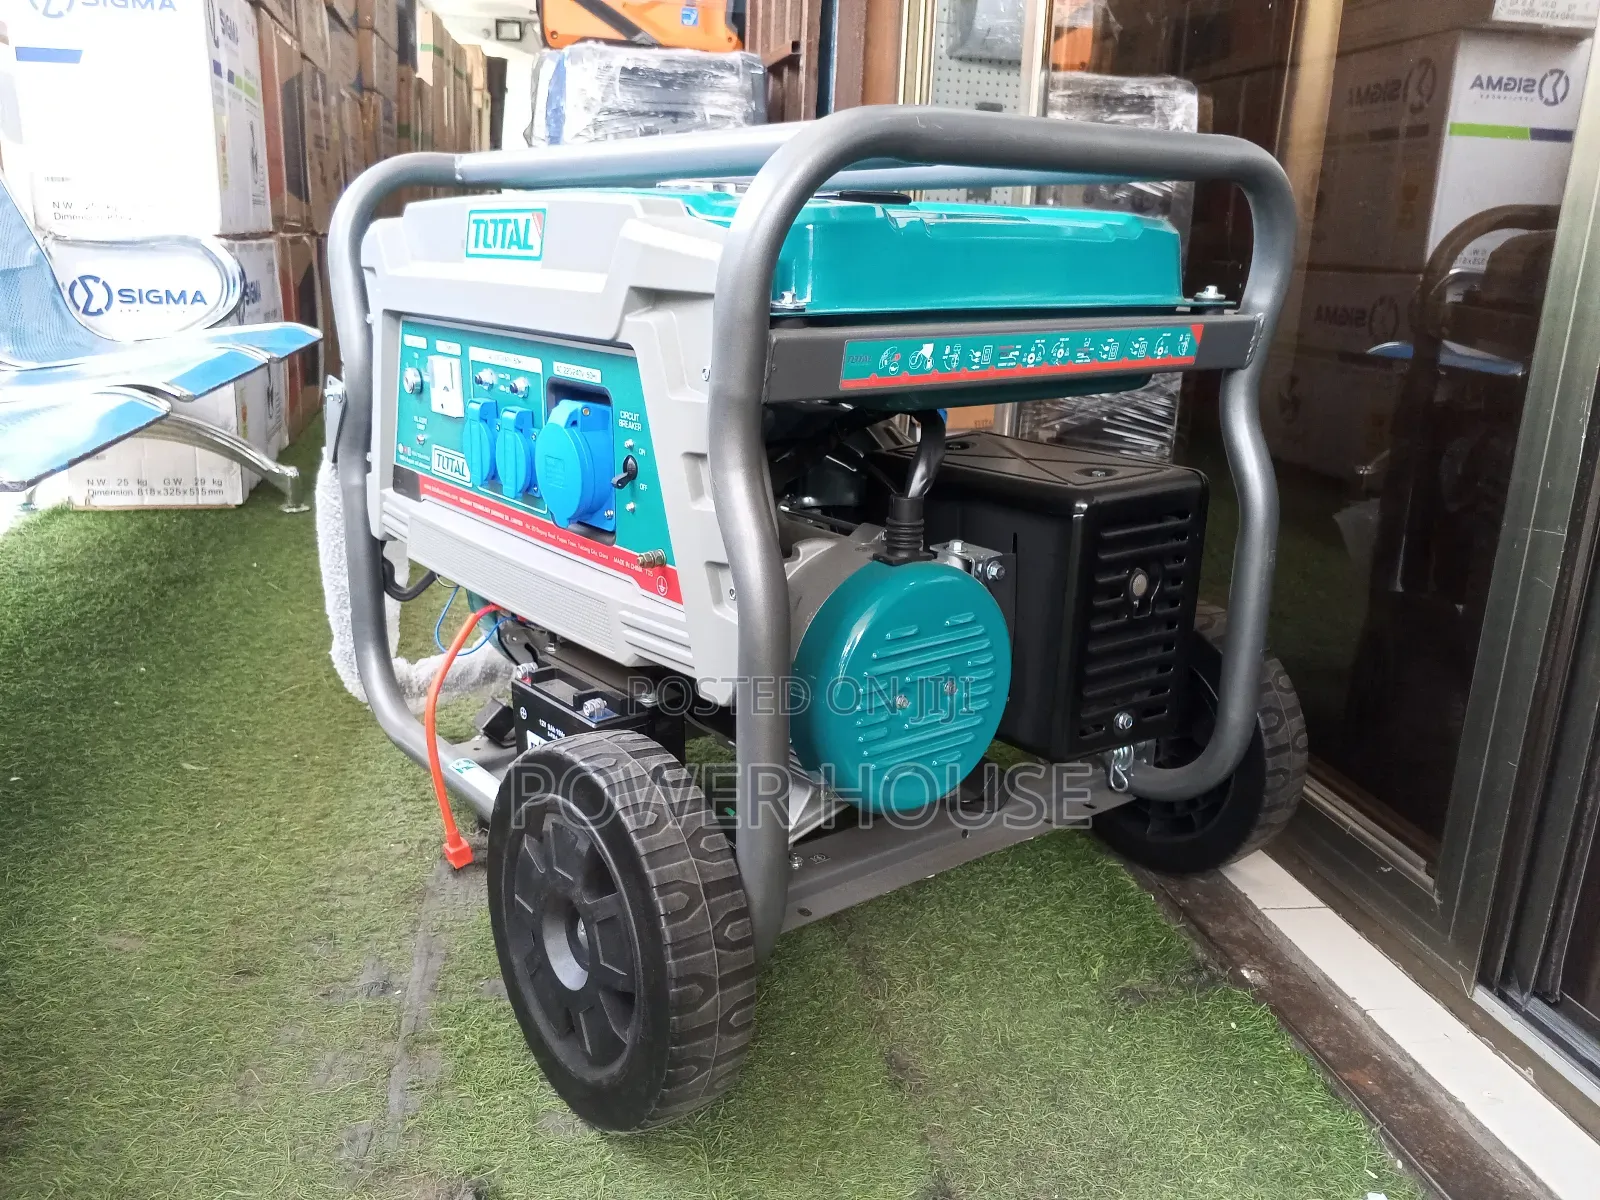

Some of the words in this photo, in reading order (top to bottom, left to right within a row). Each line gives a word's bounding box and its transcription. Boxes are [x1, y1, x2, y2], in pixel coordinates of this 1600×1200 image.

[472, 218, 534, 250] TOTAL
[117, 288, 208, 306] SIGMA
[620, 410, 640, 422] CIRCUIT
[619, 419, 642, 431] BREAKER
[639, 448, 646, 456] ON
[436, 453, 467, 477] TOTAL
[137, 479, 148, 488] kg
[212, 479, 223, 488] kg
[640, 483, 648, 491] OFF
